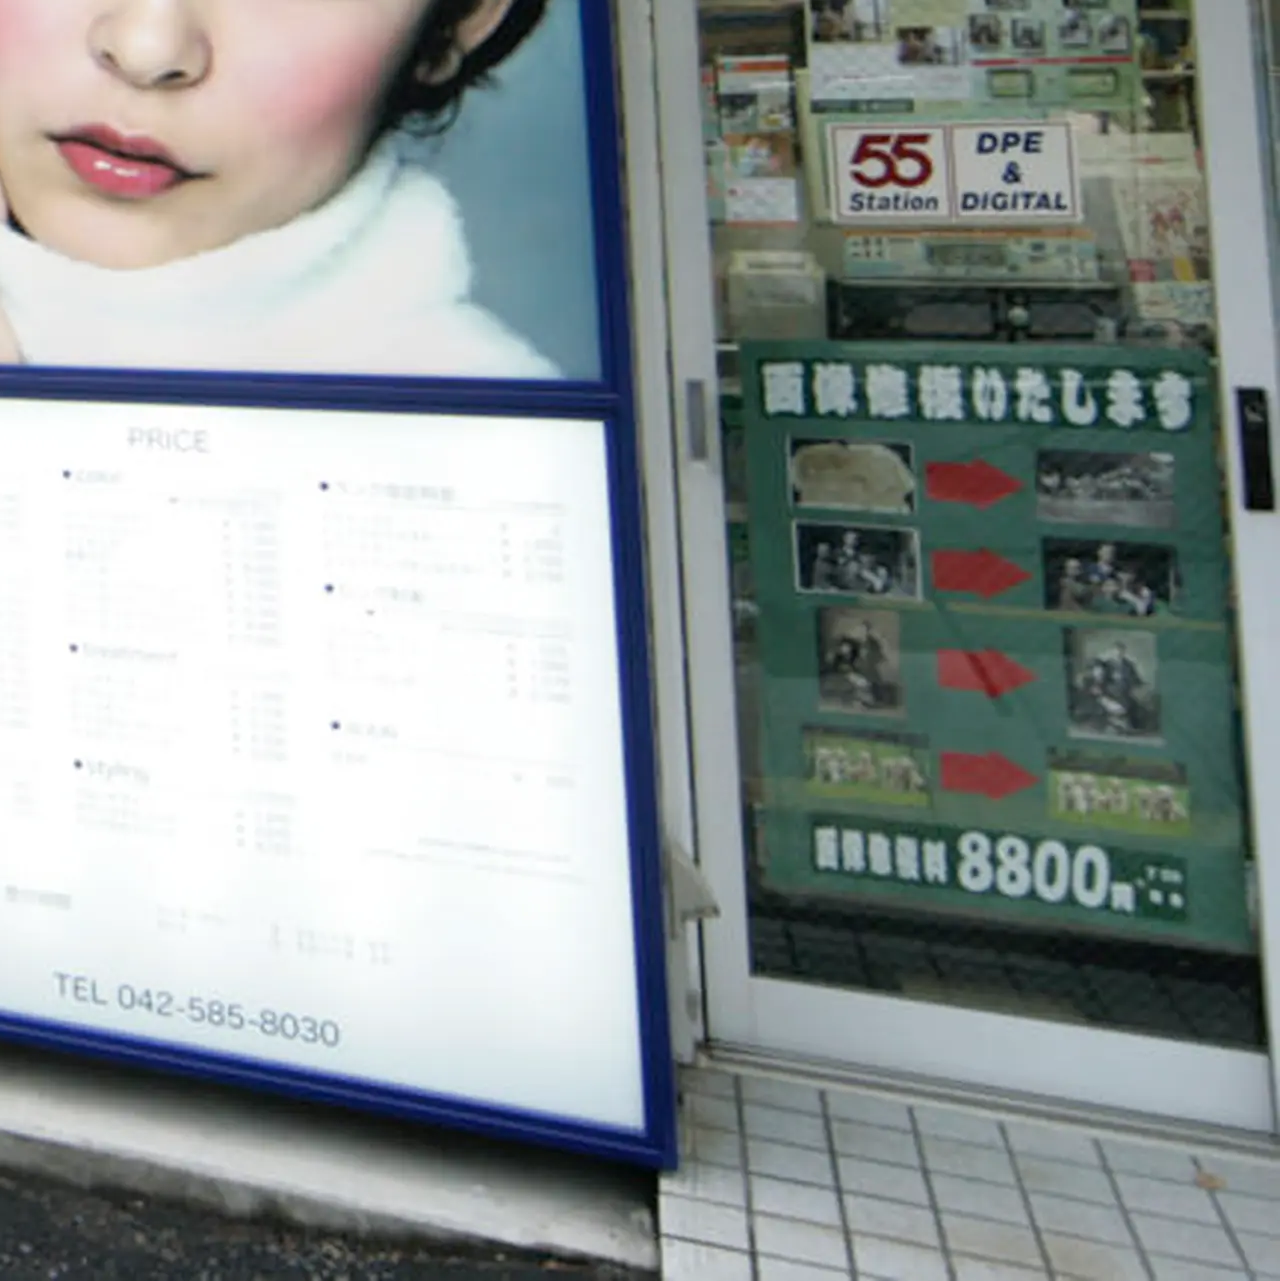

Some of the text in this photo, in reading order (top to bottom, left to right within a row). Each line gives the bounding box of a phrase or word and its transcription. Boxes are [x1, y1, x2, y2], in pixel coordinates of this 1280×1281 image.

[975, 130, 1044, 155] DPE
[850, 132, 934, 189] 55
[1001, 160, 1023, 185] &
[849, 191, 940, 212] Station
[960, 191, 1069, 212] DIGITAL
[126, 426, 211, 454] PRICE
[53, 971, 341, 1048] TEL 042-585-8030
